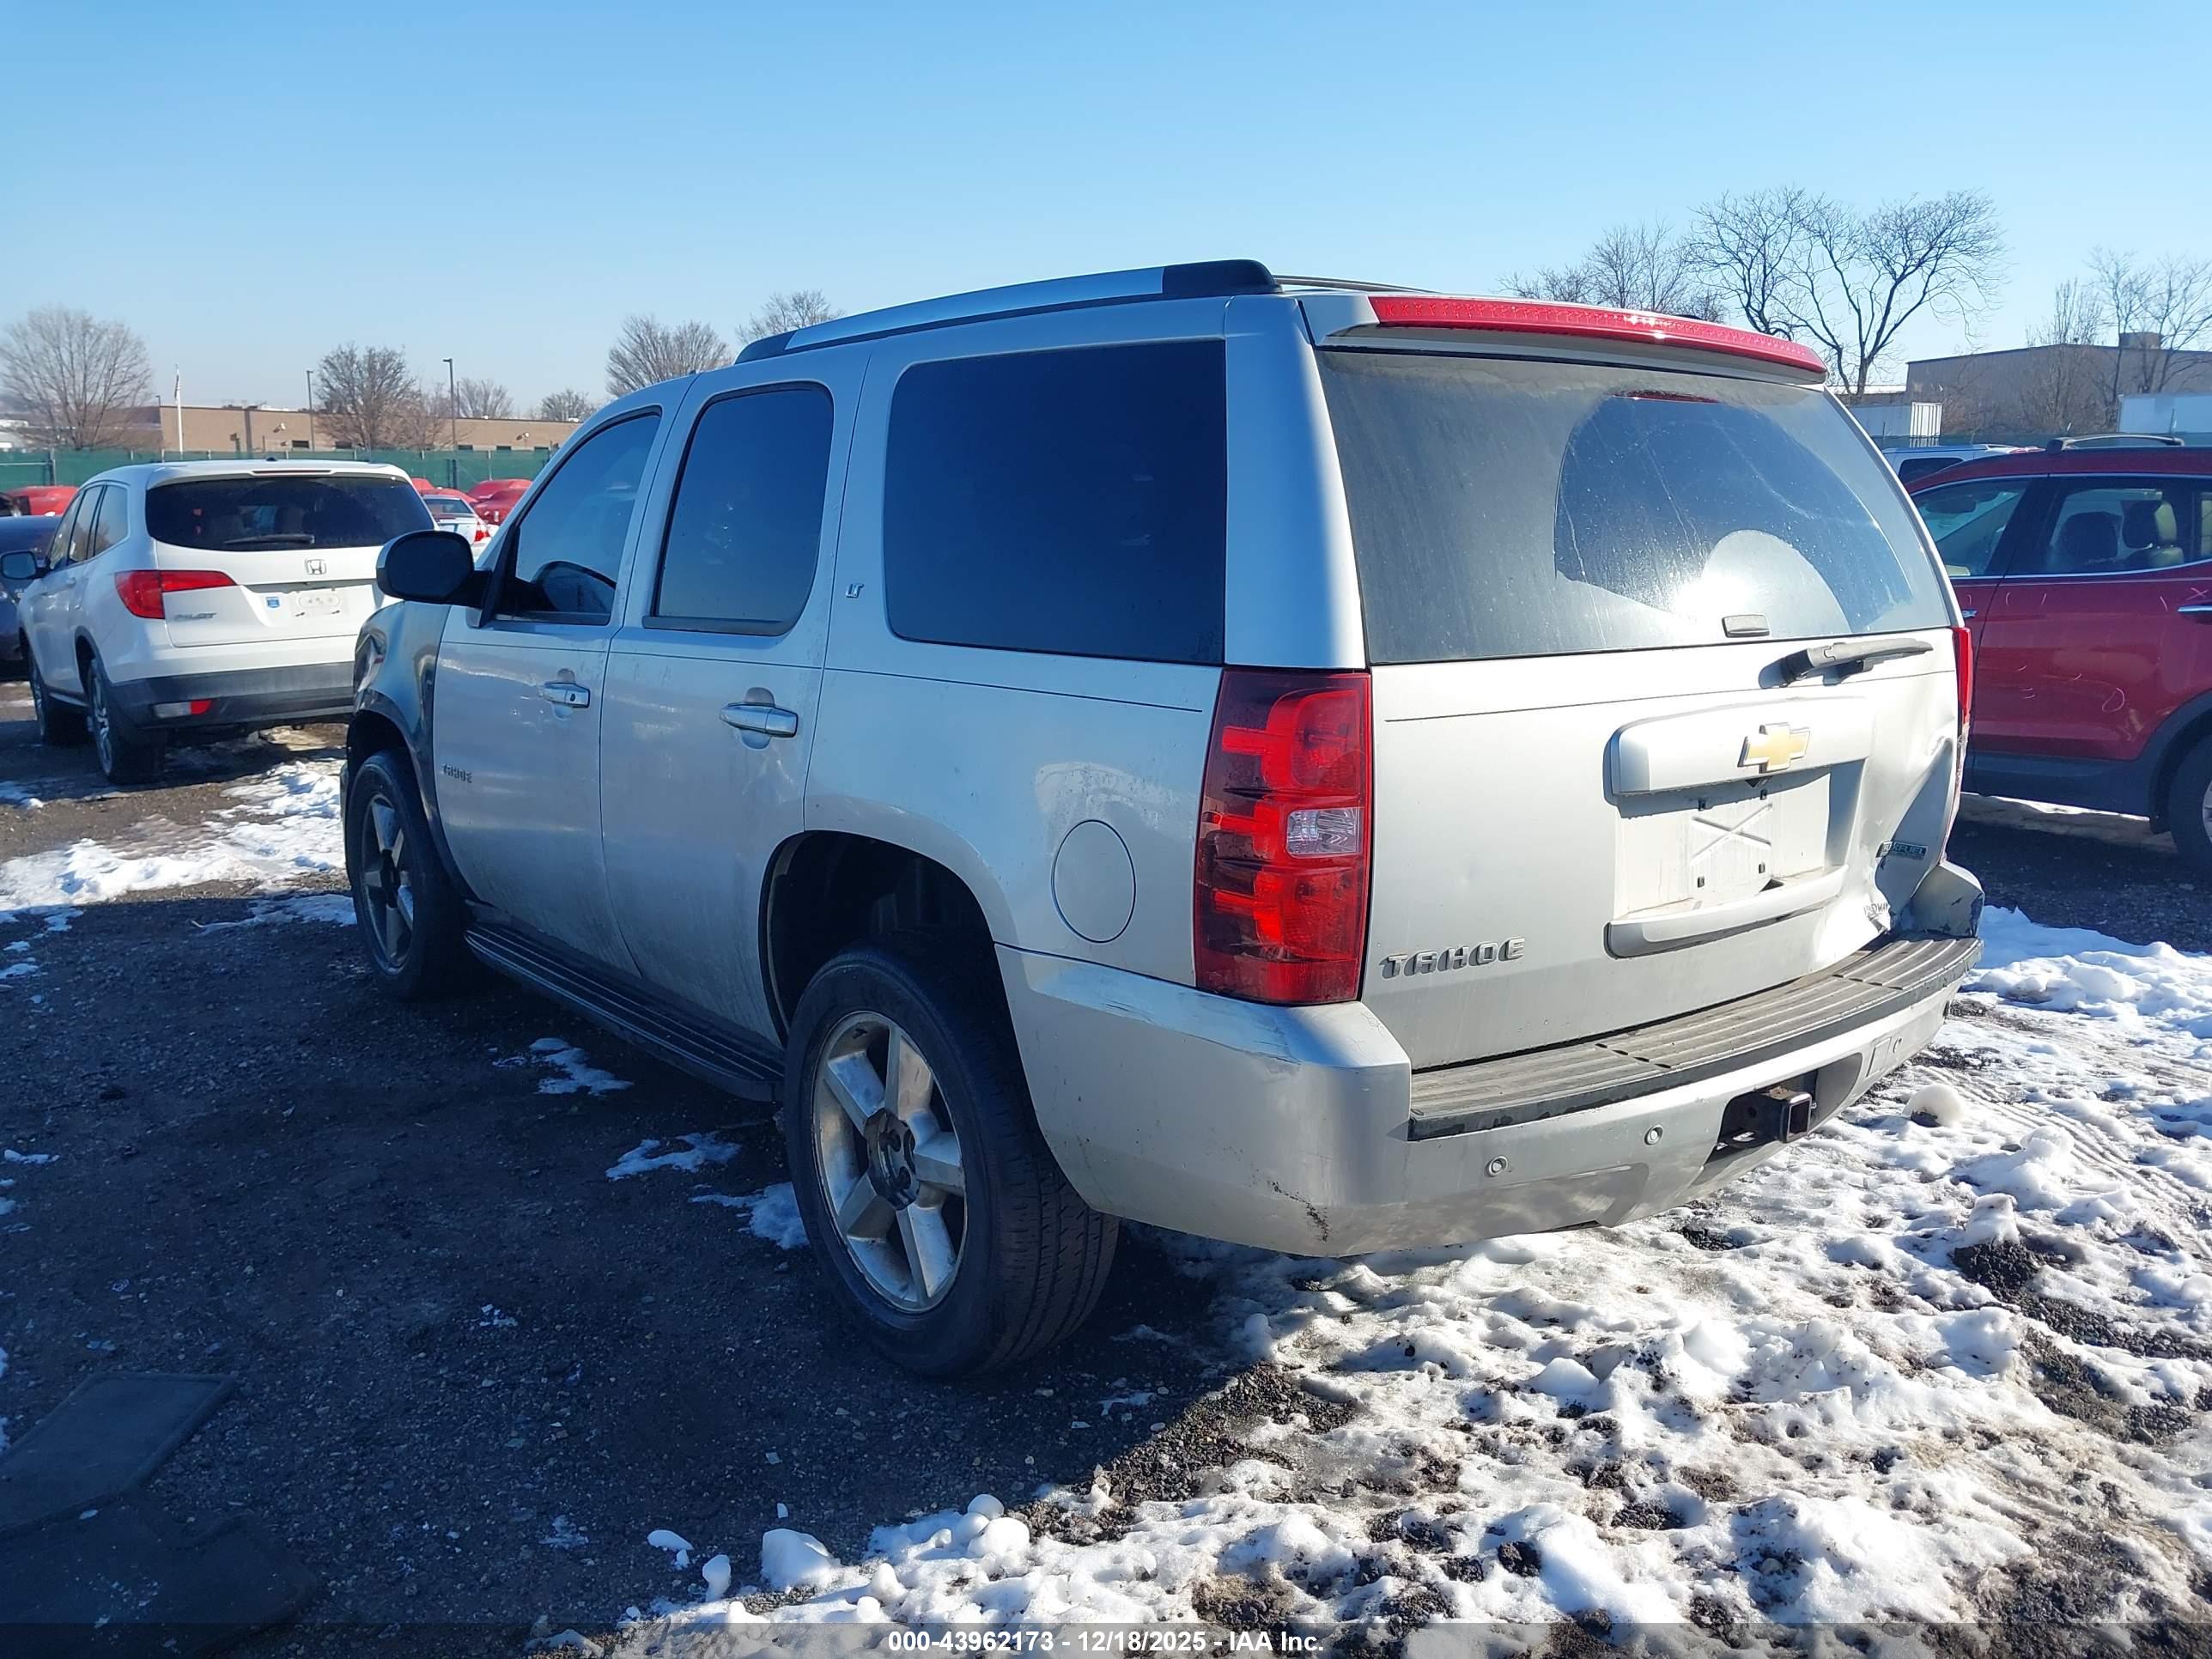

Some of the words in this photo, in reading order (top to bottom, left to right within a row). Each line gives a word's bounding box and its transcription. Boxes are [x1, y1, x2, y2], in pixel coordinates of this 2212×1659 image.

[846, 583, 865, 599] LT
[441, 762, 473, 783] TAHOE
[1378, 936, 1525, 980] TAHOE
